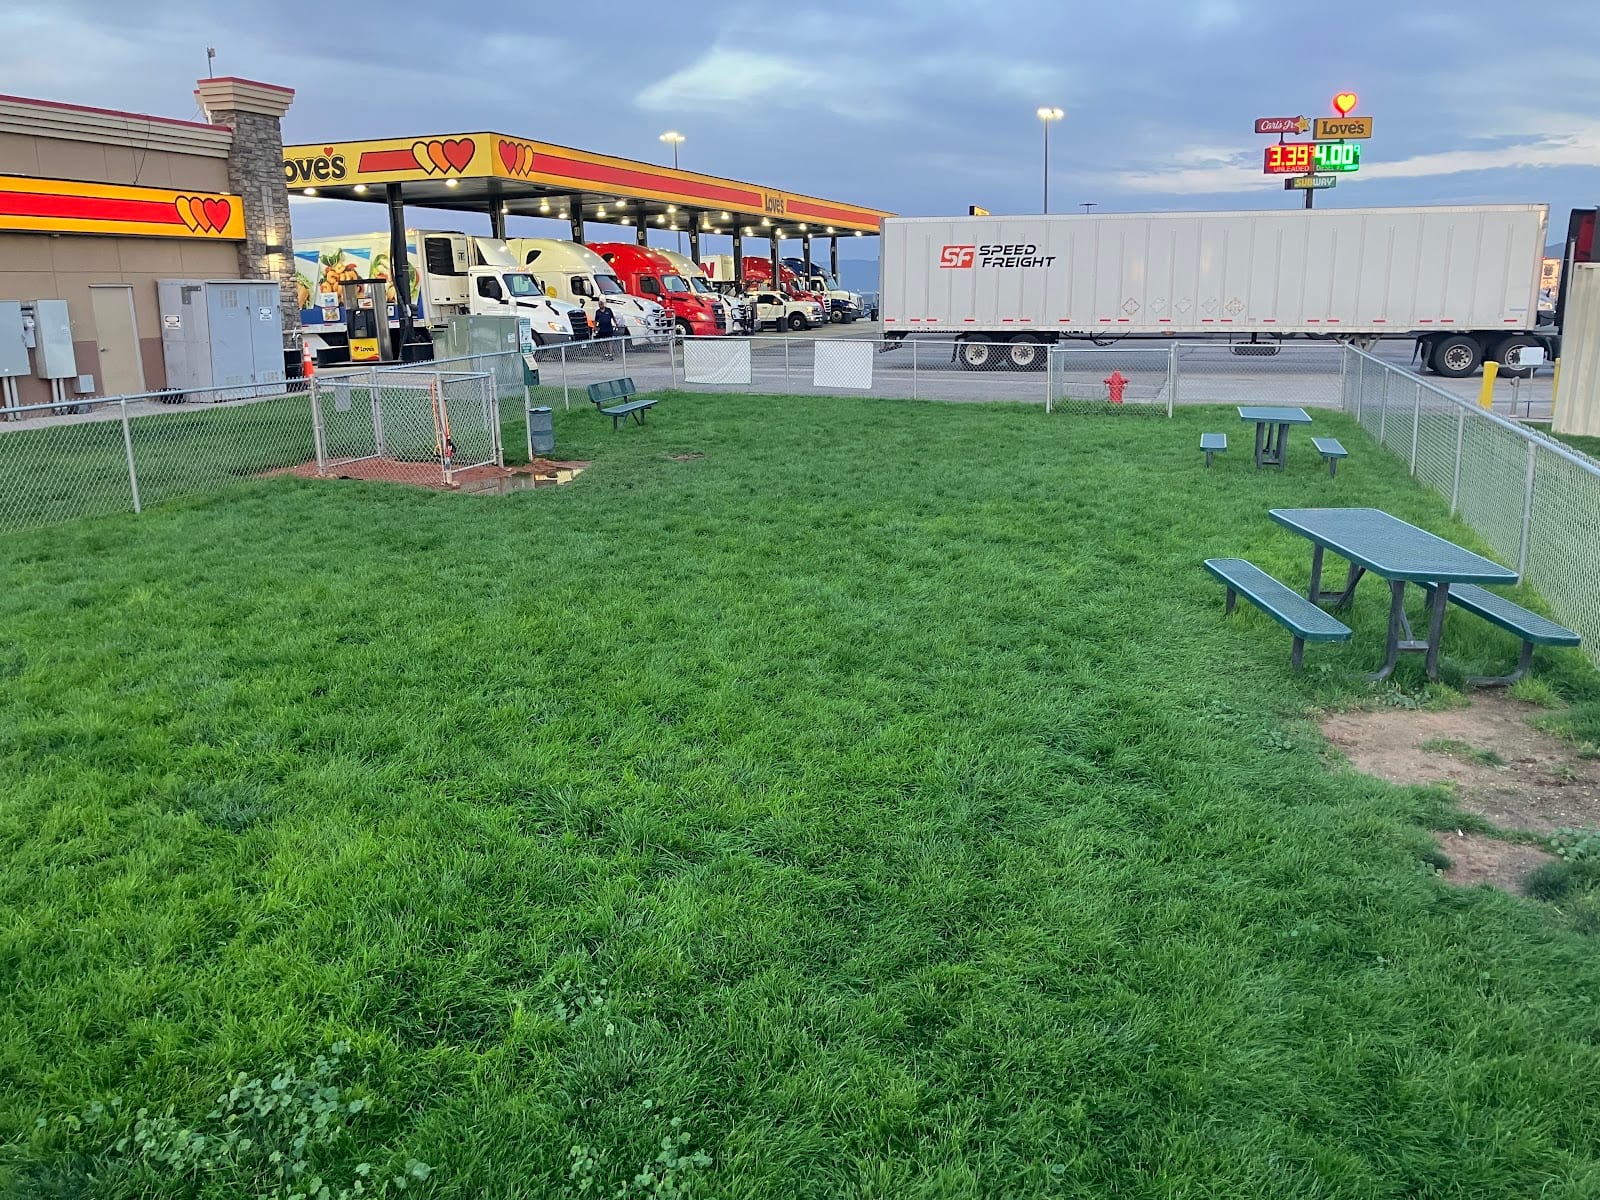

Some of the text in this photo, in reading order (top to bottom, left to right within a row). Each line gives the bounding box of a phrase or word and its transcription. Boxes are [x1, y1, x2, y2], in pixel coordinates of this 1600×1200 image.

[1273, 165, 1310, 173] UNLEADED
[1294, 177, 1335, 188] SUBWAY
[979, 244, 1037, 256] SPEED
[982, 256, 1057, 268] FREIGHT
